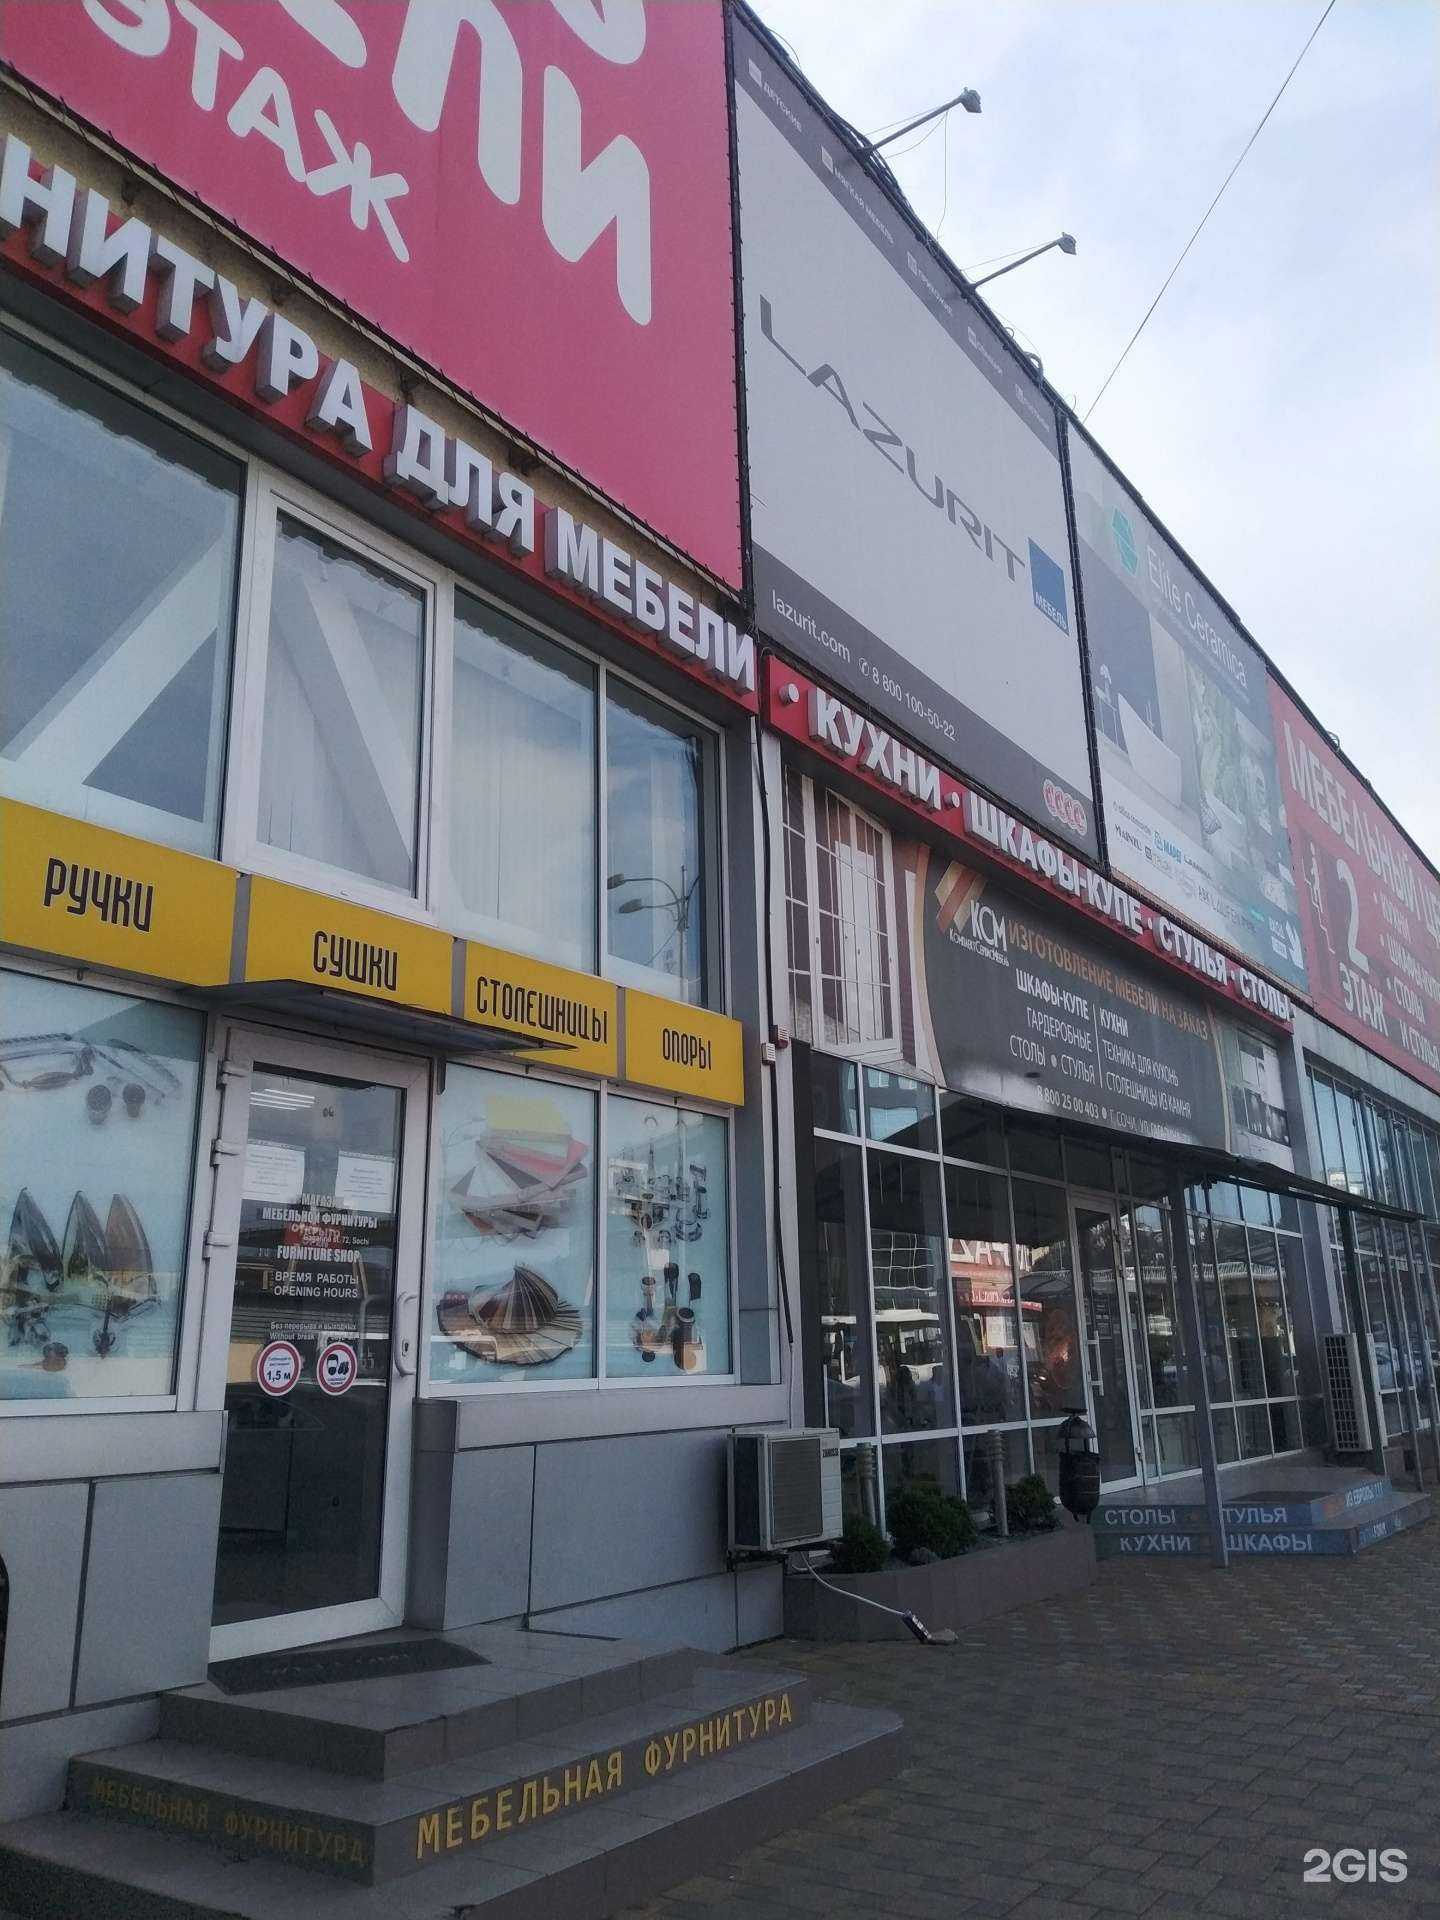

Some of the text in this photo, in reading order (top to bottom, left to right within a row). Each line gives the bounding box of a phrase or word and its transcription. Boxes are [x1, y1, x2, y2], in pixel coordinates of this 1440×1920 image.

[759, 294, 1026, 583] LAZURIT
[394, 403, 536, 556] ДЛЯ
[555, 506, 756, 692] МЕБЕЛИ
[772, 588, 851, 664] lazurit.com
[1034, 590, 1068, 630] МЕБЕЛЬ
[1146, 545, 1183, 614] Elite
[1183, 591, 1249, 690] Ceramica
[871, 668, 957, 742] 8 800 100-50-22
[815, 687, 942, 811] КУХНИ
[969, 791, 1144, 936] ШКАФЫ-КУПЕ
[1158, 916, 1228, 986] СТУЛЬЯ
[1239, 967, 1291, 1023] СТОЛЫ
[44, 857, 154, 934] РУЧКИ
[1336, 858, 1370, 974] 2
[312, 930, 399, 992] СУШКИ
[1008, 918, 1115, 993] ИЗГОТОВЛЕНИЕ
[1115, 975, 1160, 1017] МЕБЕЛИ
[475, 975, 610, 1046] СТОЛЕШНИЦЫ
[1015, 968, 1090, 1021] ШКАФЫ-КУПЕ
[1339, 962, 1389, 1038] ЭТАЖ
[1026, 1006, 1093, 1053] ГАРДЕРОБНЫЕ
[1099, 1007, 1129, 1038] КУХНИ
[661, 1027, 712, 1073] ОПОРЫ
[1009, 1034, 1096, 1085] СТОЛЫ СТУЛЬЯ
[1101, 1039, 1138, 1071] ТЕХНИКА
[1043, 1087, 1061, 1107] 800
[1061, 1093, 1073, 1110] 25
[1084, 1102, 1099, 1119] 403
[1106, 1071, 1159, 1110] СТОЛЕШНИЦЫ
[262, 1206, 378, 1229] МЕБЕЛЬНОЙ ФУРНИТУРЫ
[274, 1271, 359, 1285] ВРЕМЯ РАБОТЫ
[277, 1245, 361, 1264] FURNITURE SHOP
[274, 1285, 359, 1299] OPENING HOURS
[267, 1370, 282, 1382] 1,5
[1104, 1508, 1176, 1527] СТОЛЫ
[1223, 1533, 1313, 1552] ШКАФЫ
[1120, 1535, 1191, 1552] КУХНИ
[415, 1693, 792, 1860] МЕБЕЛЬНАЯ ФУРНИТУРА
[91, 1776, 366, 1870] МЕБЕЛЬНАЯ ФУРНИТУРА
